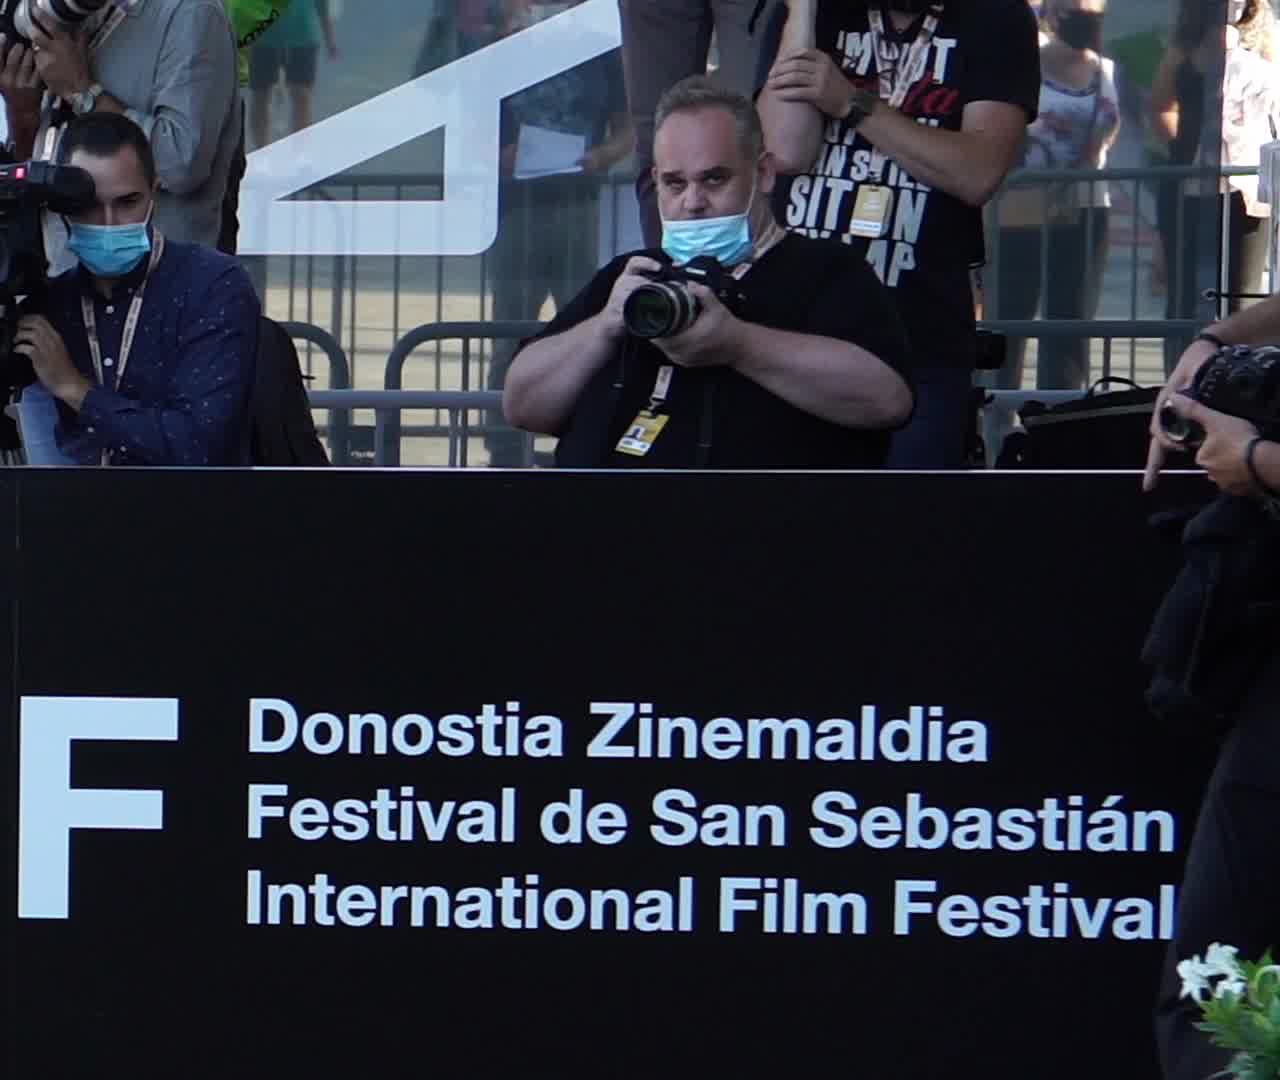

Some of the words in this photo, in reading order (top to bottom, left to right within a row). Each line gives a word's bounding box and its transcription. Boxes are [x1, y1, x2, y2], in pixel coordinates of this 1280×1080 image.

[786, 175, 855, 232] SIT
[247, 697, 564, 758] Donostia
[586, 701, 989, 763] Zinemaldia
[246, 783, 516, 843] Festival
[540, 788, 629, 845] de
[649, 788, 786, 847] San
[808, 790, 1175, 853] Sebastián
[245, 869, 694, 934] International
[718, 876, 868, 935] Film
[893, 879, 1175, 941] Festival
